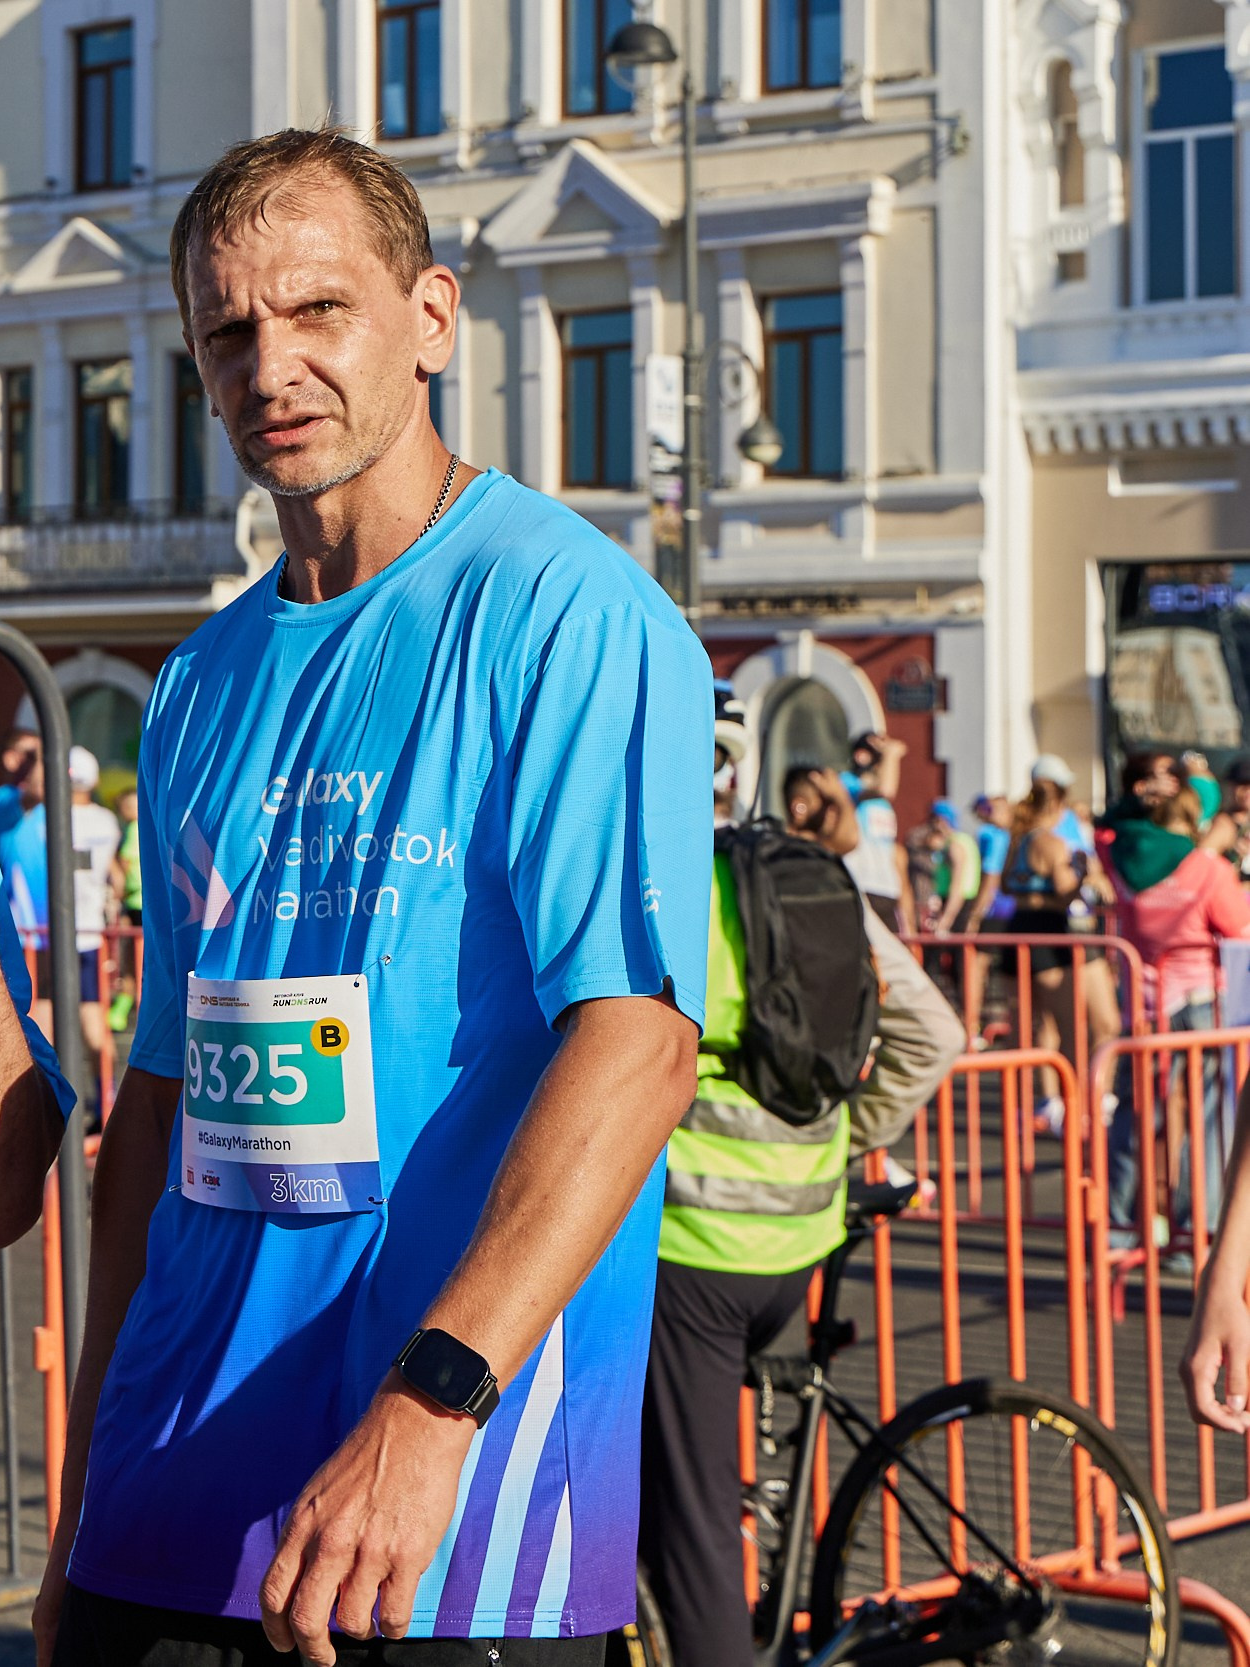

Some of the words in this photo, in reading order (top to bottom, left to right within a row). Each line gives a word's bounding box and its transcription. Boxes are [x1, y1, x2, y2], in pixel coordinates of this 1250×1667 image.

[260, 768, 384, 816] Glaxy
[258, 823, 457, 873] Vadivostok
[200, 995, 219, 1006] DNS
[320, 1025, 342, 1048] B
[188, 1039, 308, 1106] 9325
[198, 1131, 291, 1150] #GalaxyMarathon
[270, 1172, 343, 1203] 3km
